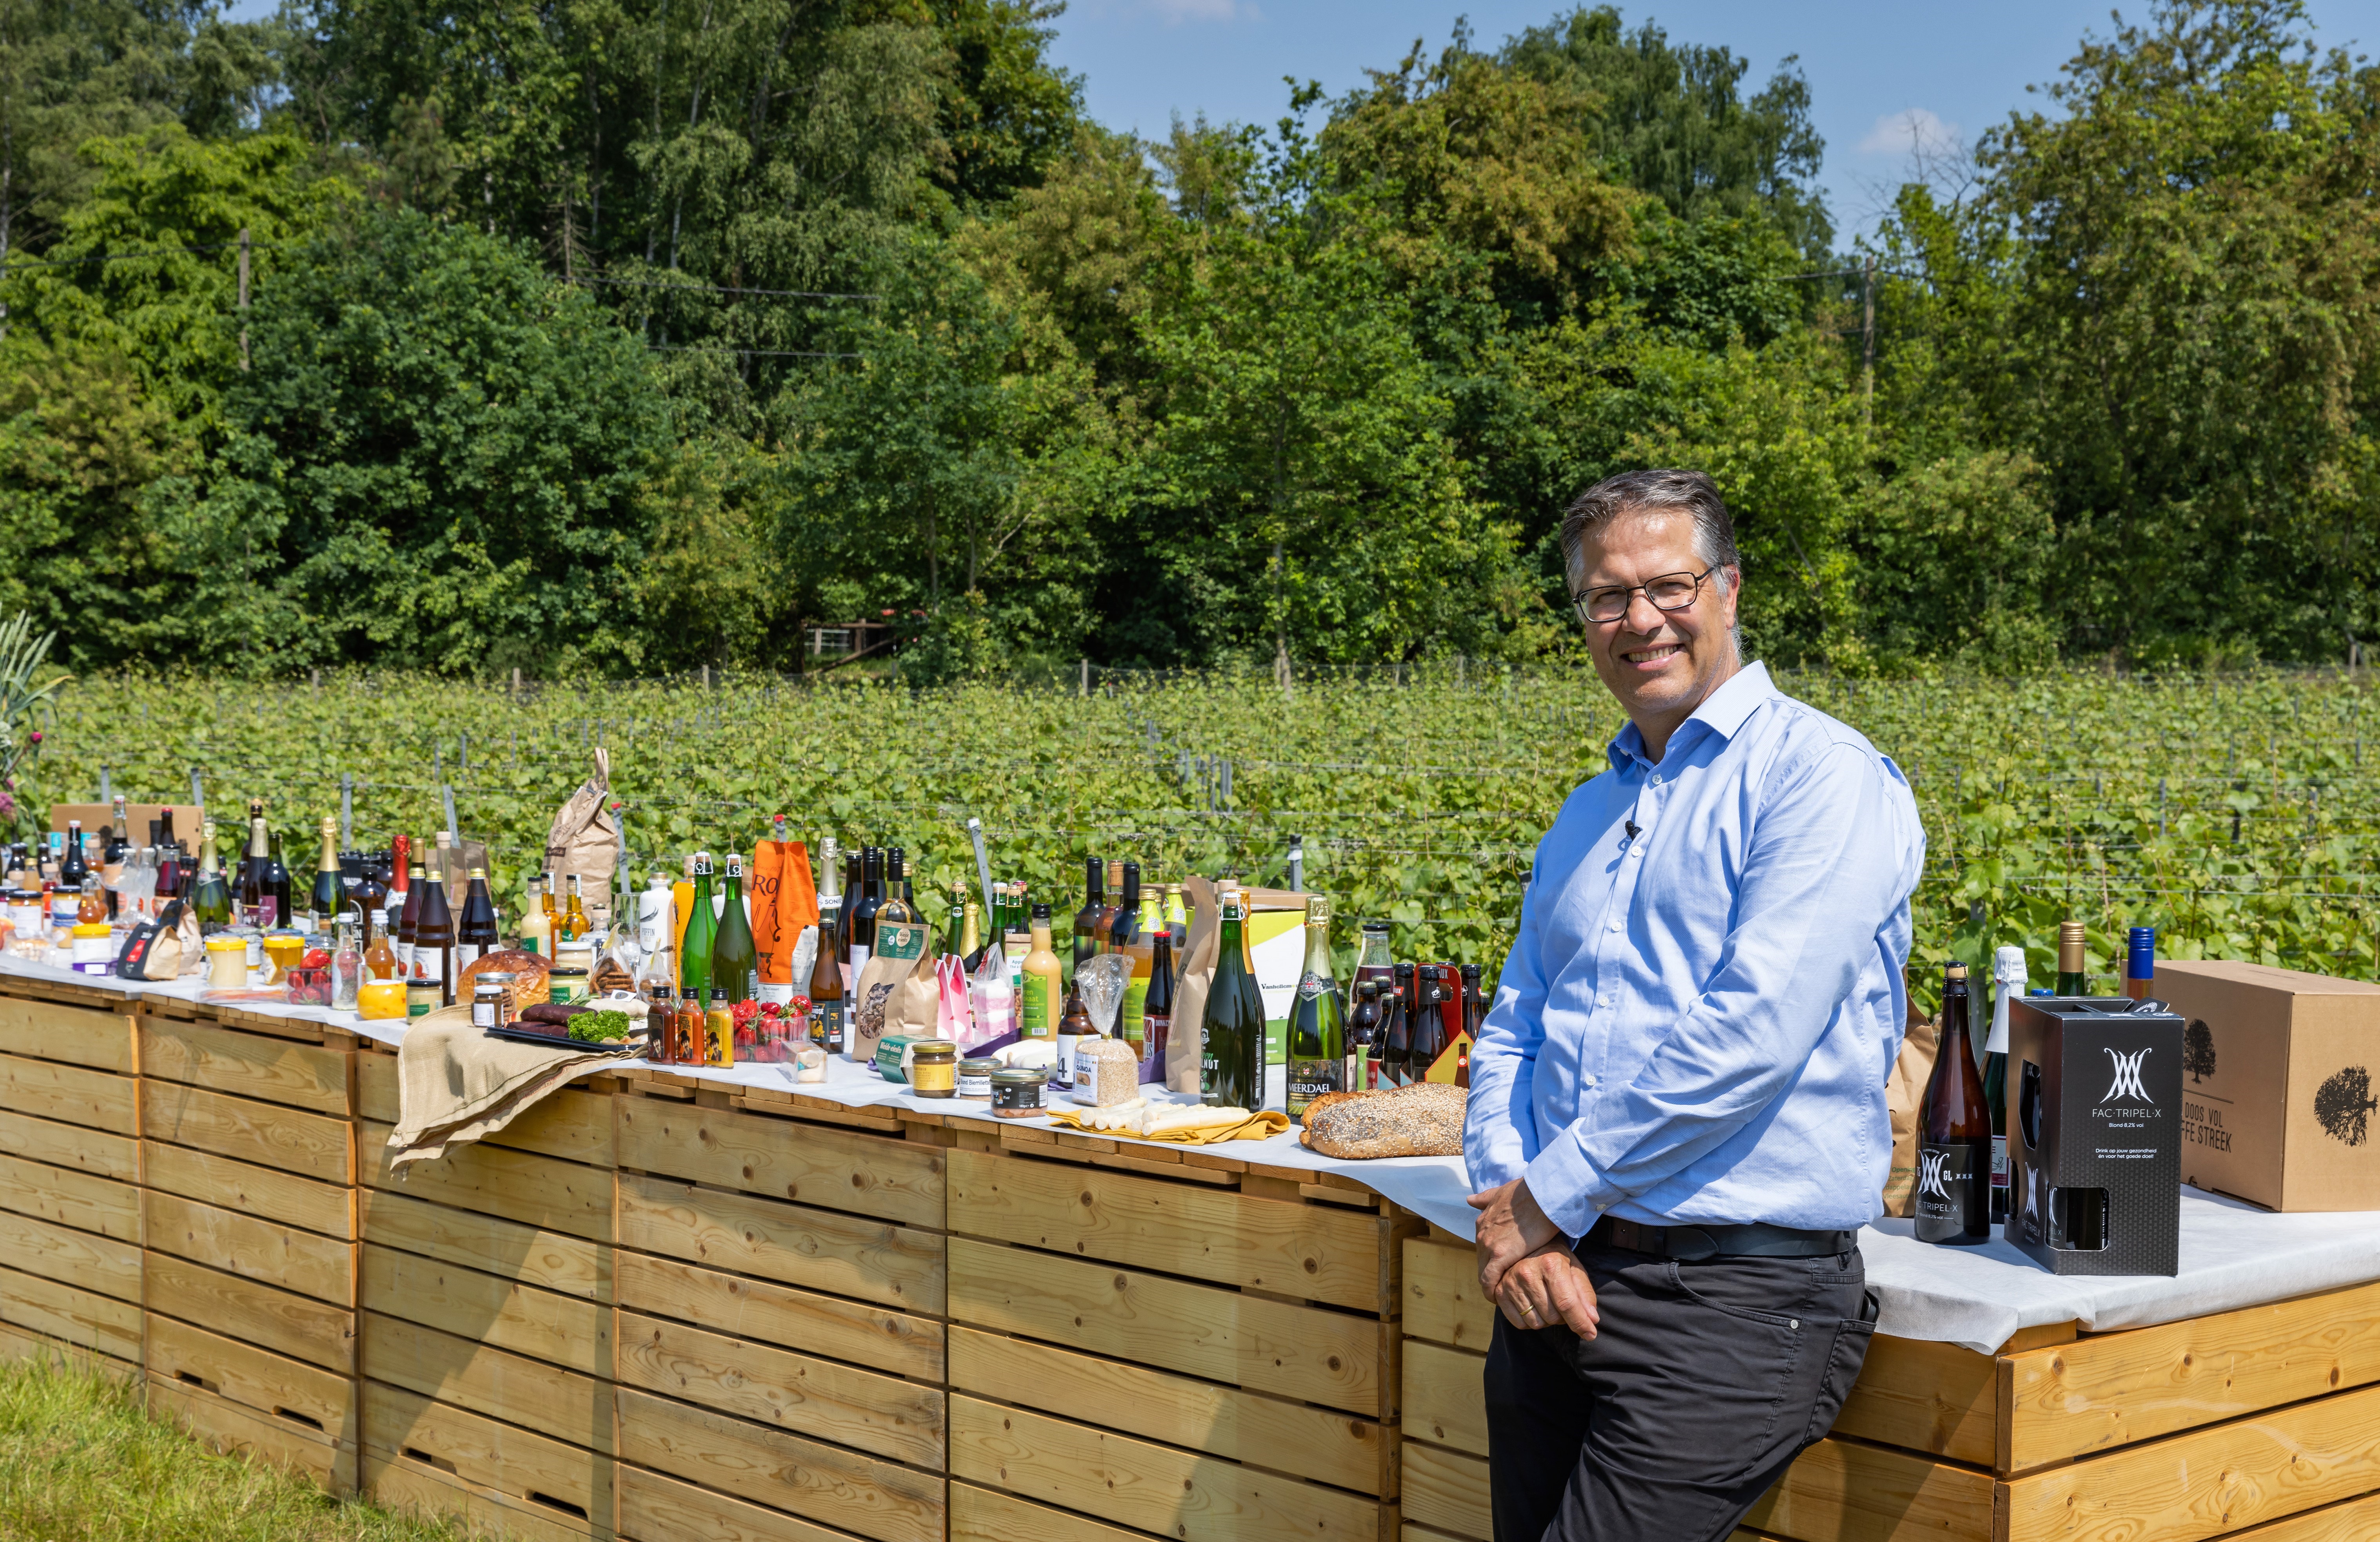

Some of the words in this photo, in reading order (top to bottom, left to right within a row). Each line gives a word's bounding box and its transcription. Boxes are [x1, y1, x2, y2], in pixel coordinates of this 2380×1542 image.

[642, 928, 655, 936] PUFFIN
[1076, 1065, 1092, 1073] QUINOA
[1200, 1059, 1219, 1070] LNUT
[1288, 1083, 1331, 1093] MEERDAEL
[2185, 1102, 2204, 1122] DOOS
[2209, 1108, 2223, 1128] VOL
[2198, 1125, 2232, 1153] STREEK
[1943, 1170, 1952, 1181] CL
